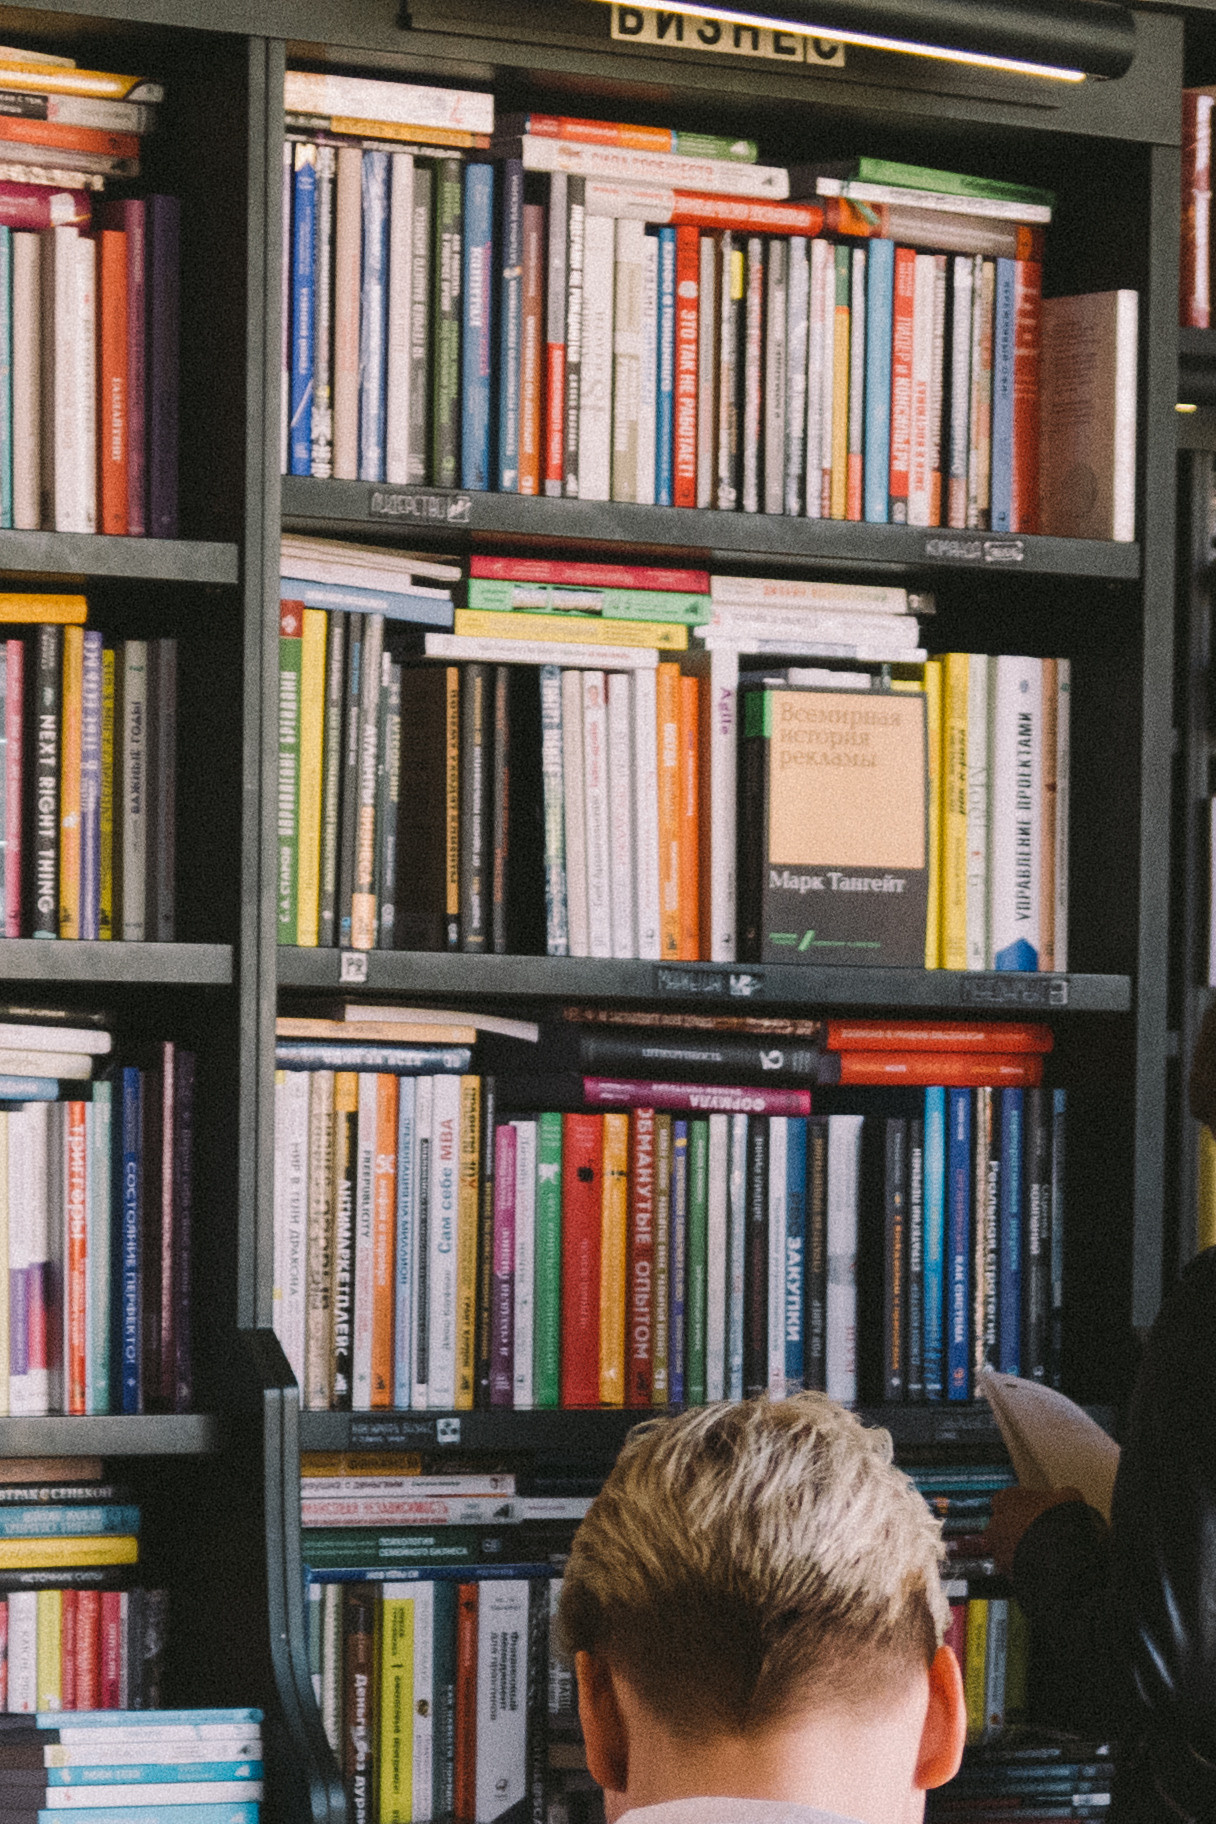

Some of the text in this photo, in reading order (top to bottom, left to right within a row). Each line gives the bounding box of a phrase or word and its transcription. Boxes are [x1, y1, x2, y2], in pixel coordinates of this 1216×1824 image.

[895, 315, 912, 361] ЛИДЕР
[678, 309, 697, 478] ЭТО ТАК НЕ РАБОТАЕТ!
[893, 377, 909, 472] КОНСИЛЬЕРИ
[130, 700, 143, 814] ВАЖНЫЕ ГОДЫ
[717, 687, 732, 736] Agile
[780, 702, 901, 729] Всемирная
[780, 729, 870, 749] история
[780, 749, 877, 770] рекламы
[38, 714, 55, 914] NEXT RIGHT THING
[359, 723, 376, 885] АТЛАНТЫ БИЗНЕСА
[1014, 711, 1033, 921] УПРАВЛЕНИЕ ПРОЕКТАМИ
[768, 870, 906, 894] Марк Тангейт
[288, 1142, 301, 1296] МИР В ТЕНИ ДРАКОНА
[438, 1118, 453, 1254] Сам себе MBA
[124, 1161, 138, 1364] СОСТОЯНИЕ ПЕРФЕКТО!
[953, 1255, 964, 1344] КАК СИСТЕМА
[986, 1160, 999, 1346] Реальная стратегия
[635, 1260, 651, 1360] ОПЫТОМ
[354, 1672, 369, 1771] Деньги без
